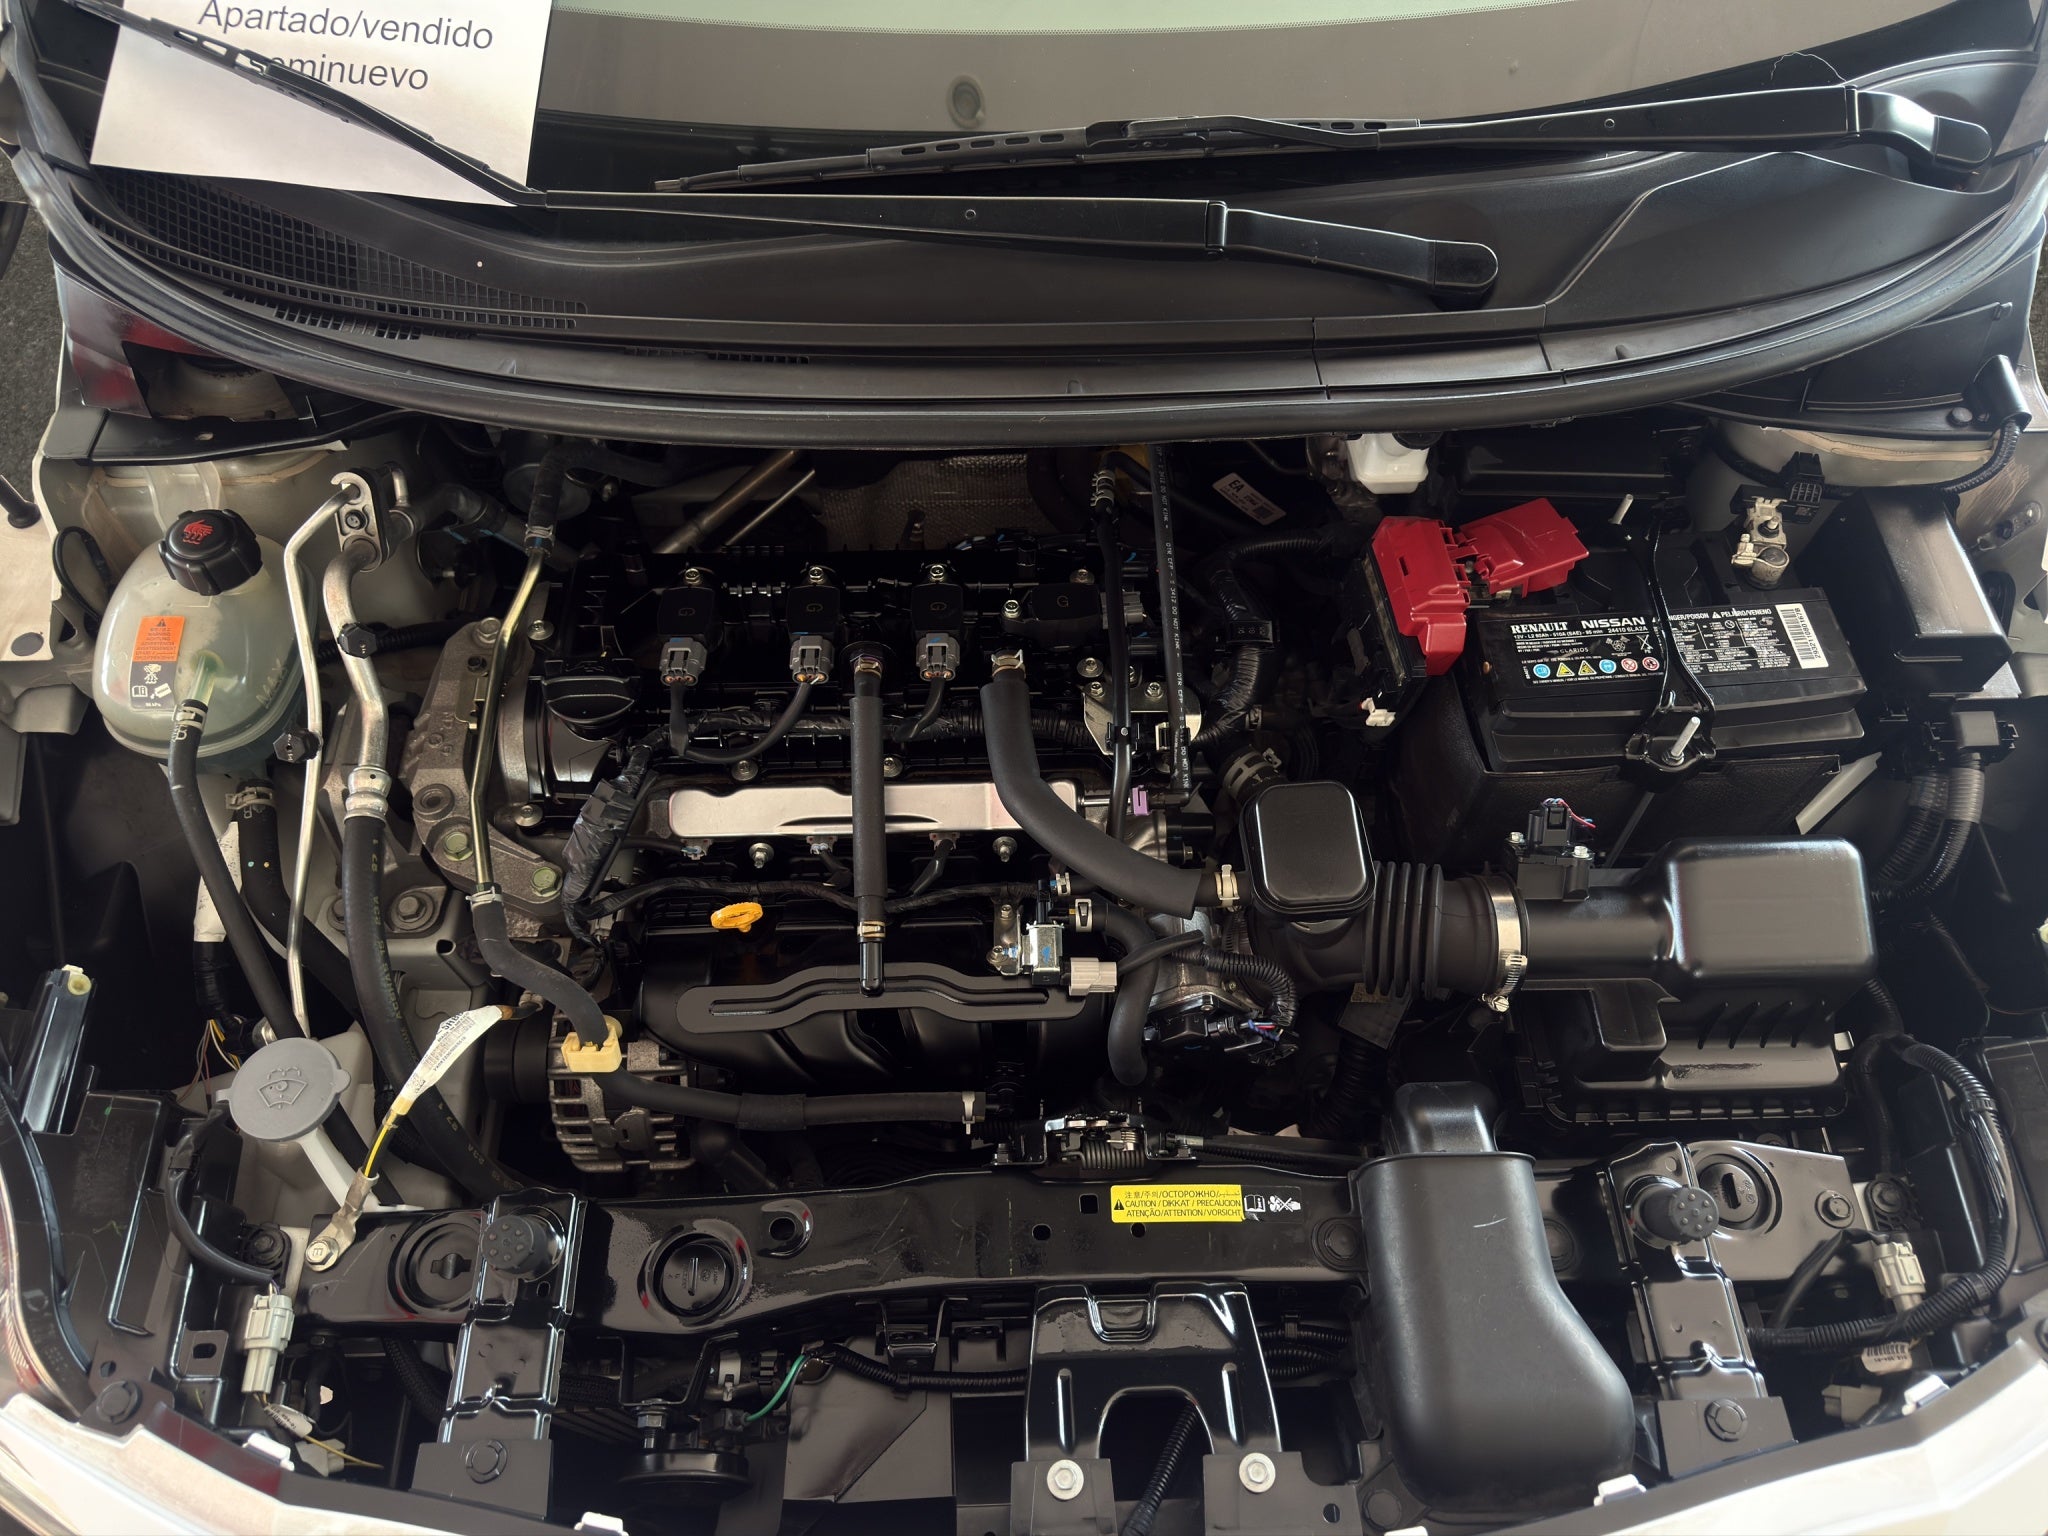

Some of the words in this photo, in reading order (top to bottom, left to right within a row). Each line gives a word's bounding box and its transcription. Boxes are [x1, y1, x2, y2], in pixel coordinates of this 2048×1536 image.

[198, 0, 493, 49] Apartado/vendido
[1510, 622, 1568, 634] RENAULT
[1581, 616, 1645, 630] NISSAN
